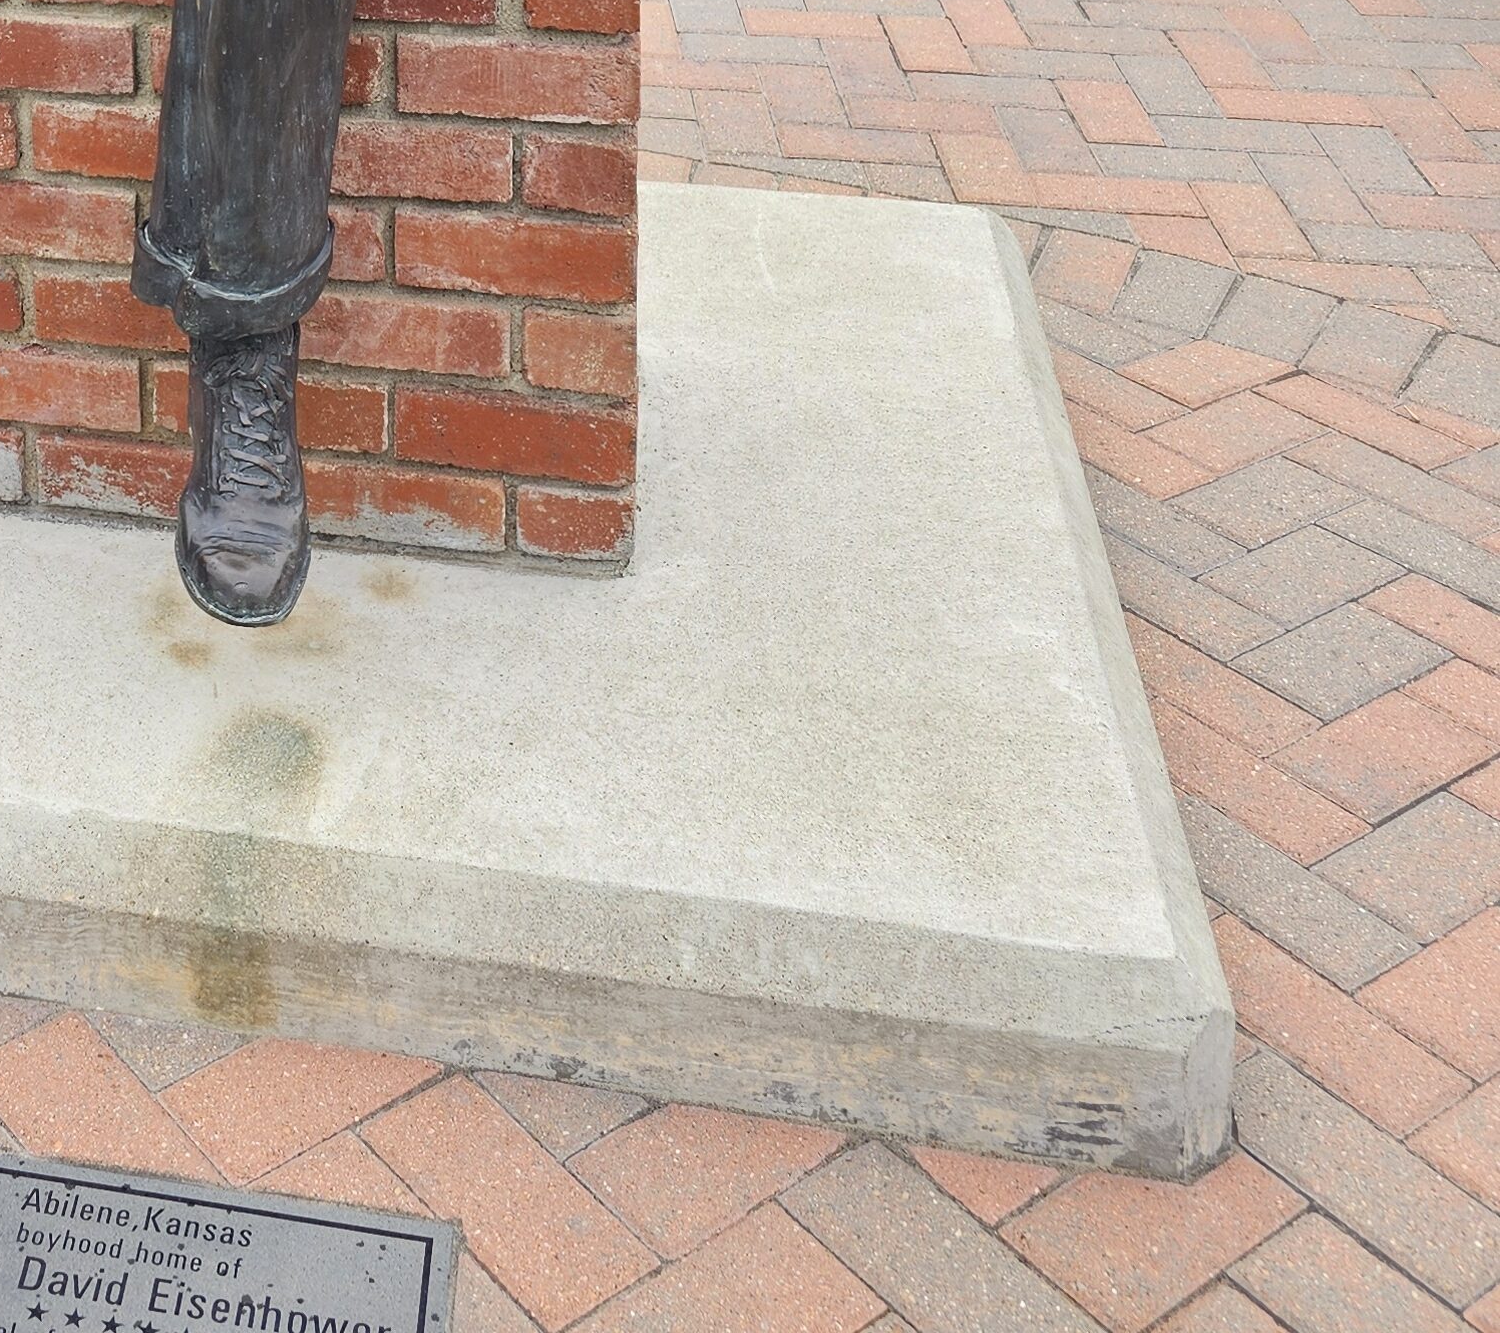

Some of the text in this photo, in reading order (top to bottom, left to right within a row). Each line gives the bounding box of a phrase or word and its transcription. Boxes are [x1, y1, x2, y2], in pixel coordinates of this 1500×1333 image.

[16, 1222, 243, 1279] boyhood home of
[17, 1255, 129, 1306] David
[148, 1277, 392, 1333] Eisenhow
